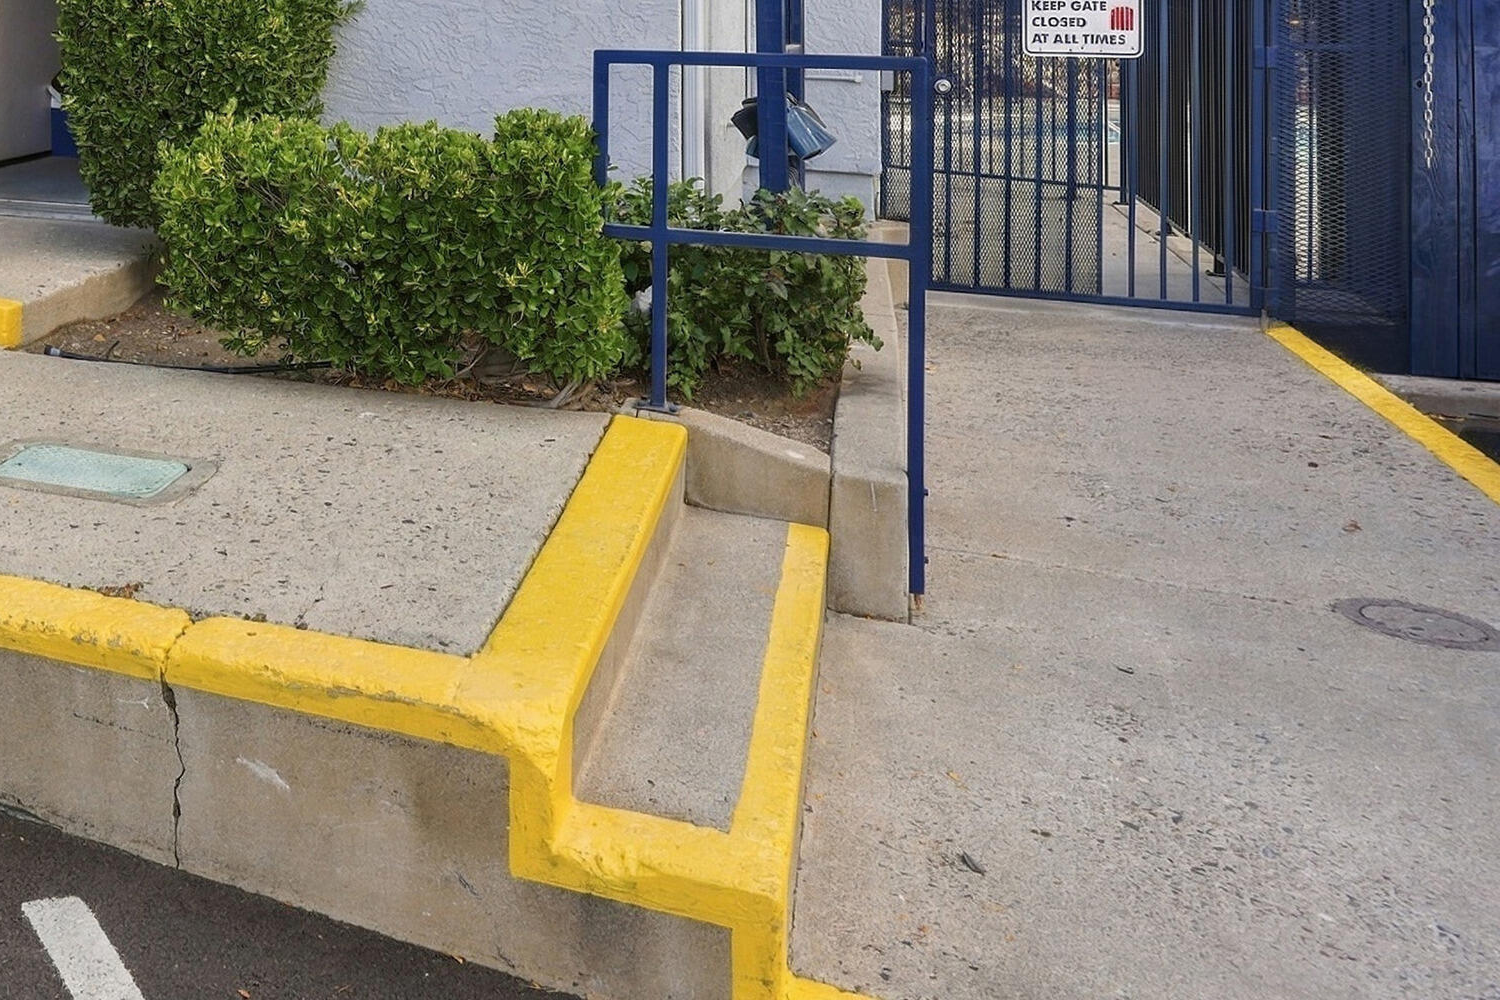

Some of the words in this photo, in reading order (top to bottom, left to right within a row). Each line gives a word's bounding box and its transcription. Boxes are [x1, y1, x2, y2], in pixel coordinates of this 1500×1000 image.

[1031, 0, 1067, 11] KEEP
[1070, 0, 1108, 11] GATE
[1031, 17, 1087, 28] CLOSED
[1031, 33, 1050, 44] AT
[1053, 33, 1079, 45] ALL
[1082, 33, 1127, 46] TIMES
